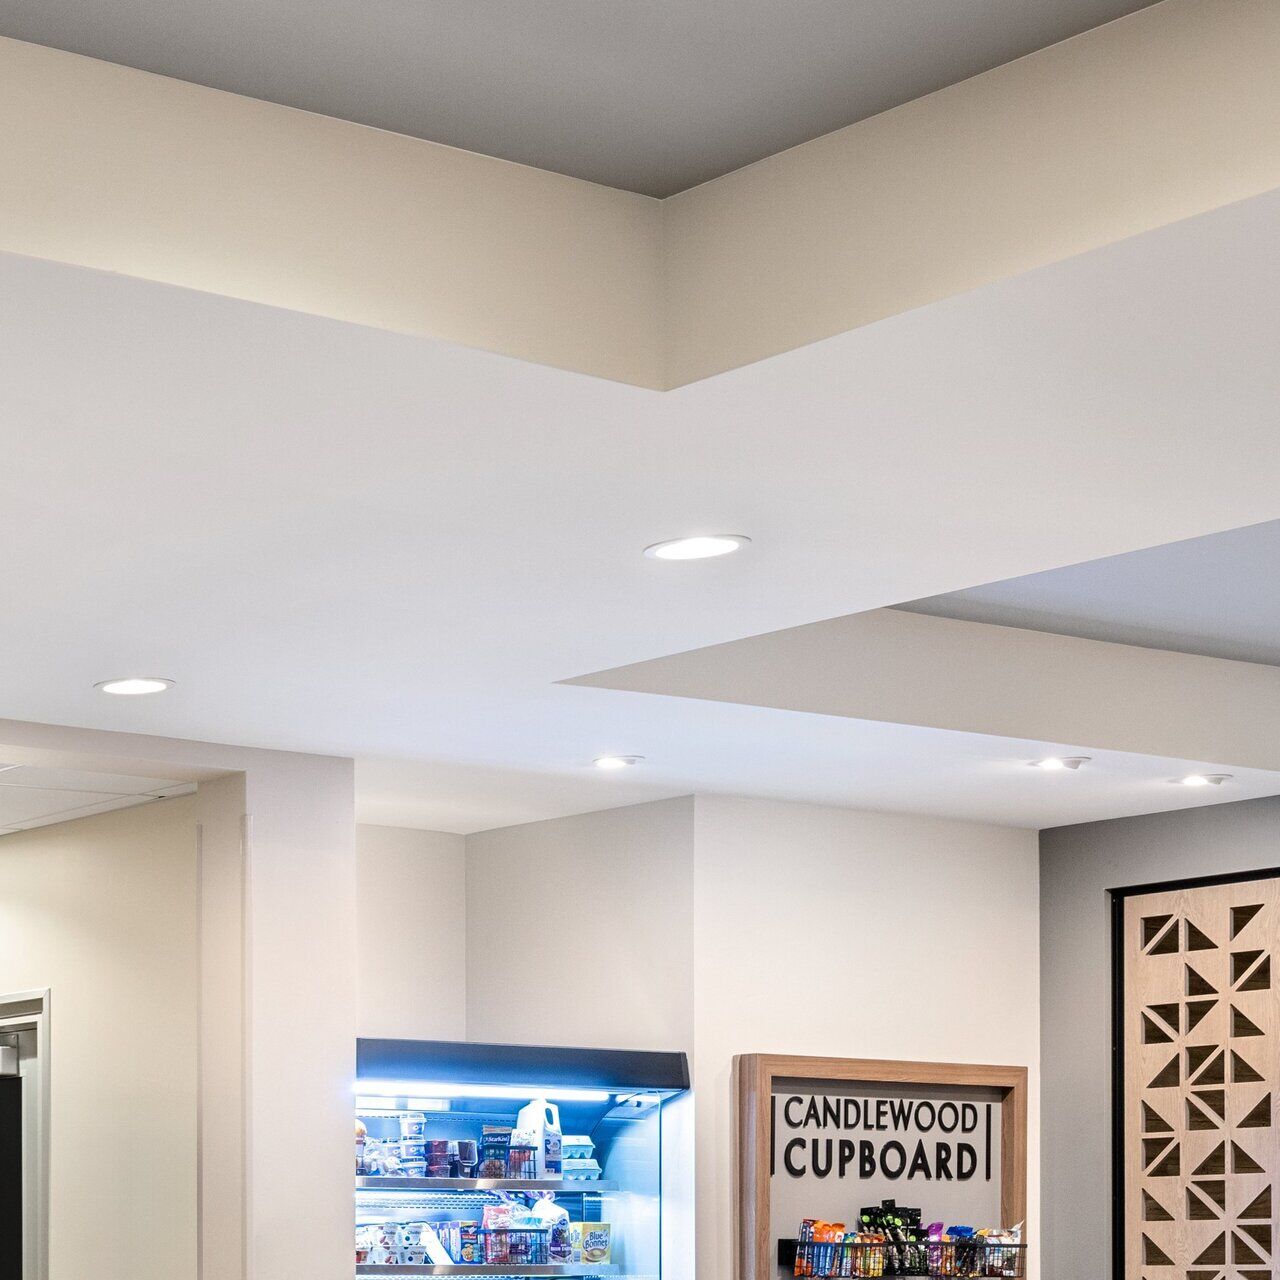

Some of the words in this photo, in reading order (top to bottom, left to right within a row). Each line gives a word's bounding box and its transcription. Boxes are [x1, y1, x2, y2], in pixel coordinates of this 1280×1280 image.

[784, 1095, 978, 1133] CANDLEWOOD
[783, 1137, 978, 1181] CUPBOARD
[584, 1239, 608, 1250] Bonnet
[589, 1231, 604, 1241] Blue
